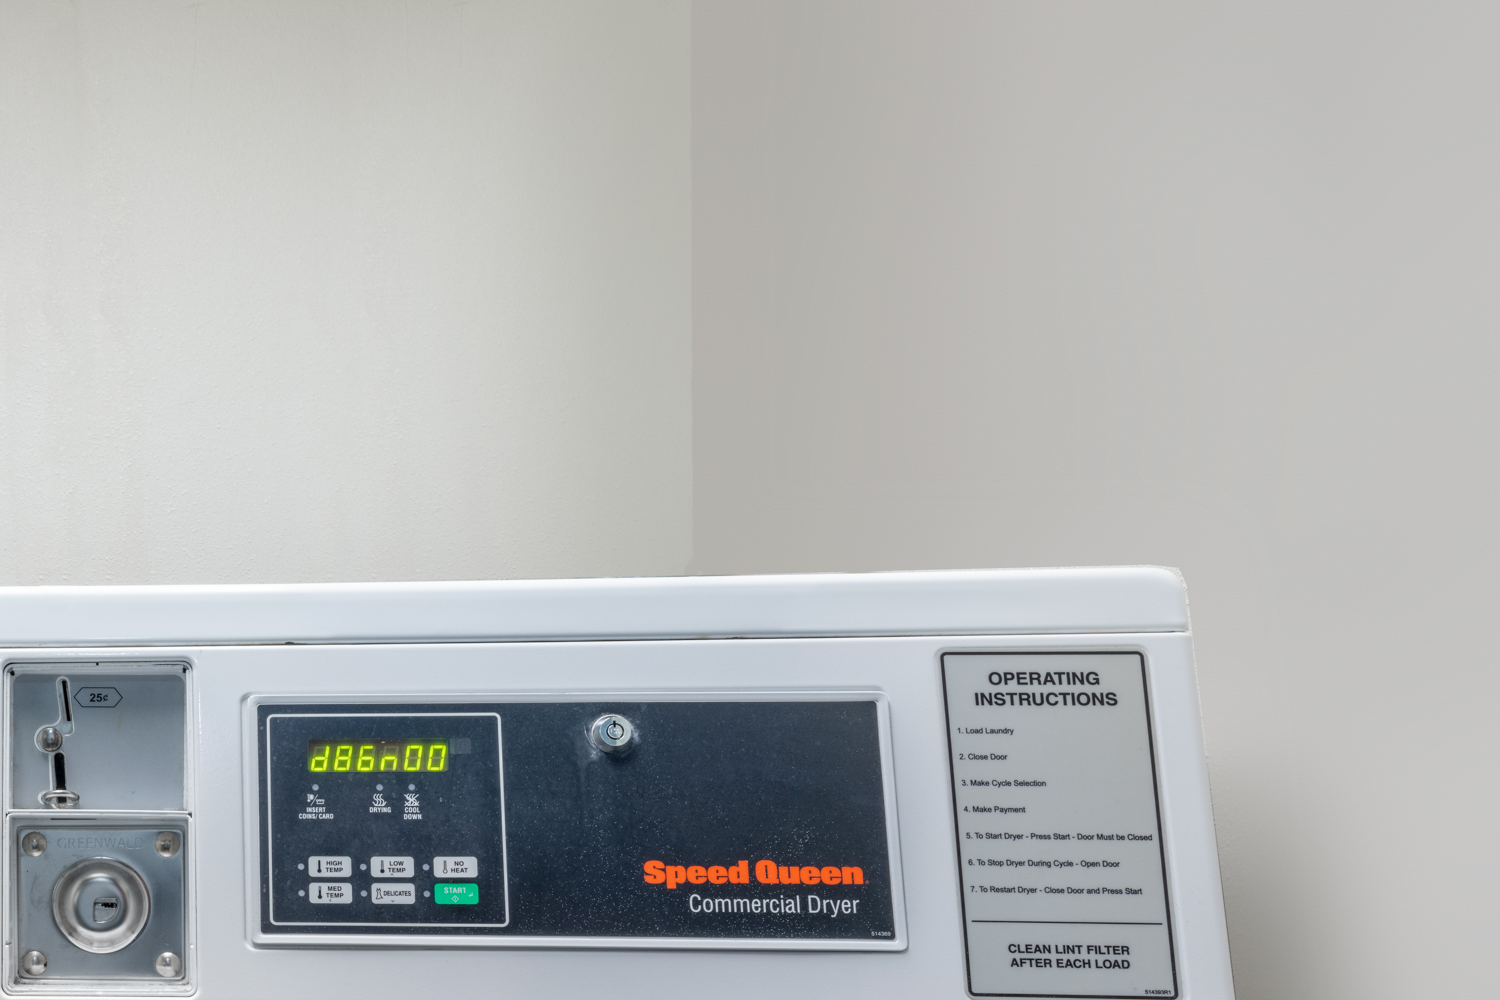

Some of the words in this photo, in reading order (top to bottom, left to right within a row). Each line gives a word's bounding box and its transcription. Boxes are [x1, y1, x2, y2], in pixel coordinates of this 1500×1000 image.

[988, 672, 1100, 685] OPERATING
[975, 692, 1118, 706] INSTRUCTIONS
[992, 780, 1012, 788] Cycle
[994, 806, 1026, 814] Payment
[1004, 833, 1024, 841] Dryer
[58, 837, 144, 850] GREENWALD
[988, 859, 1004, 867] Stop
[1006, 859, 1026, 868] Dryer
[1028, 860, 1051, 868] During
[1053, 860, 1074, 868] Cycle
[1080, 860, 1100, 868] Open
[644, 860, 749, 889] Speed
[755, 860, 864, 885] Queen
[1018, 886, 1037, 895] Dryer
[690, 894, 800, 915] Commercial
[808, 895, 859, 917] Dryer
[1008, 944, 1051, 954] CLEAN
[1055, 945, 1082, 954] LINT
[1087, 945, 1130, 955] FILTER
[1011, 958, 1052, 968] AFTER
[1056, 959, 1091, 968] EACH
[1095, 959, 1130, 969] LOAD
